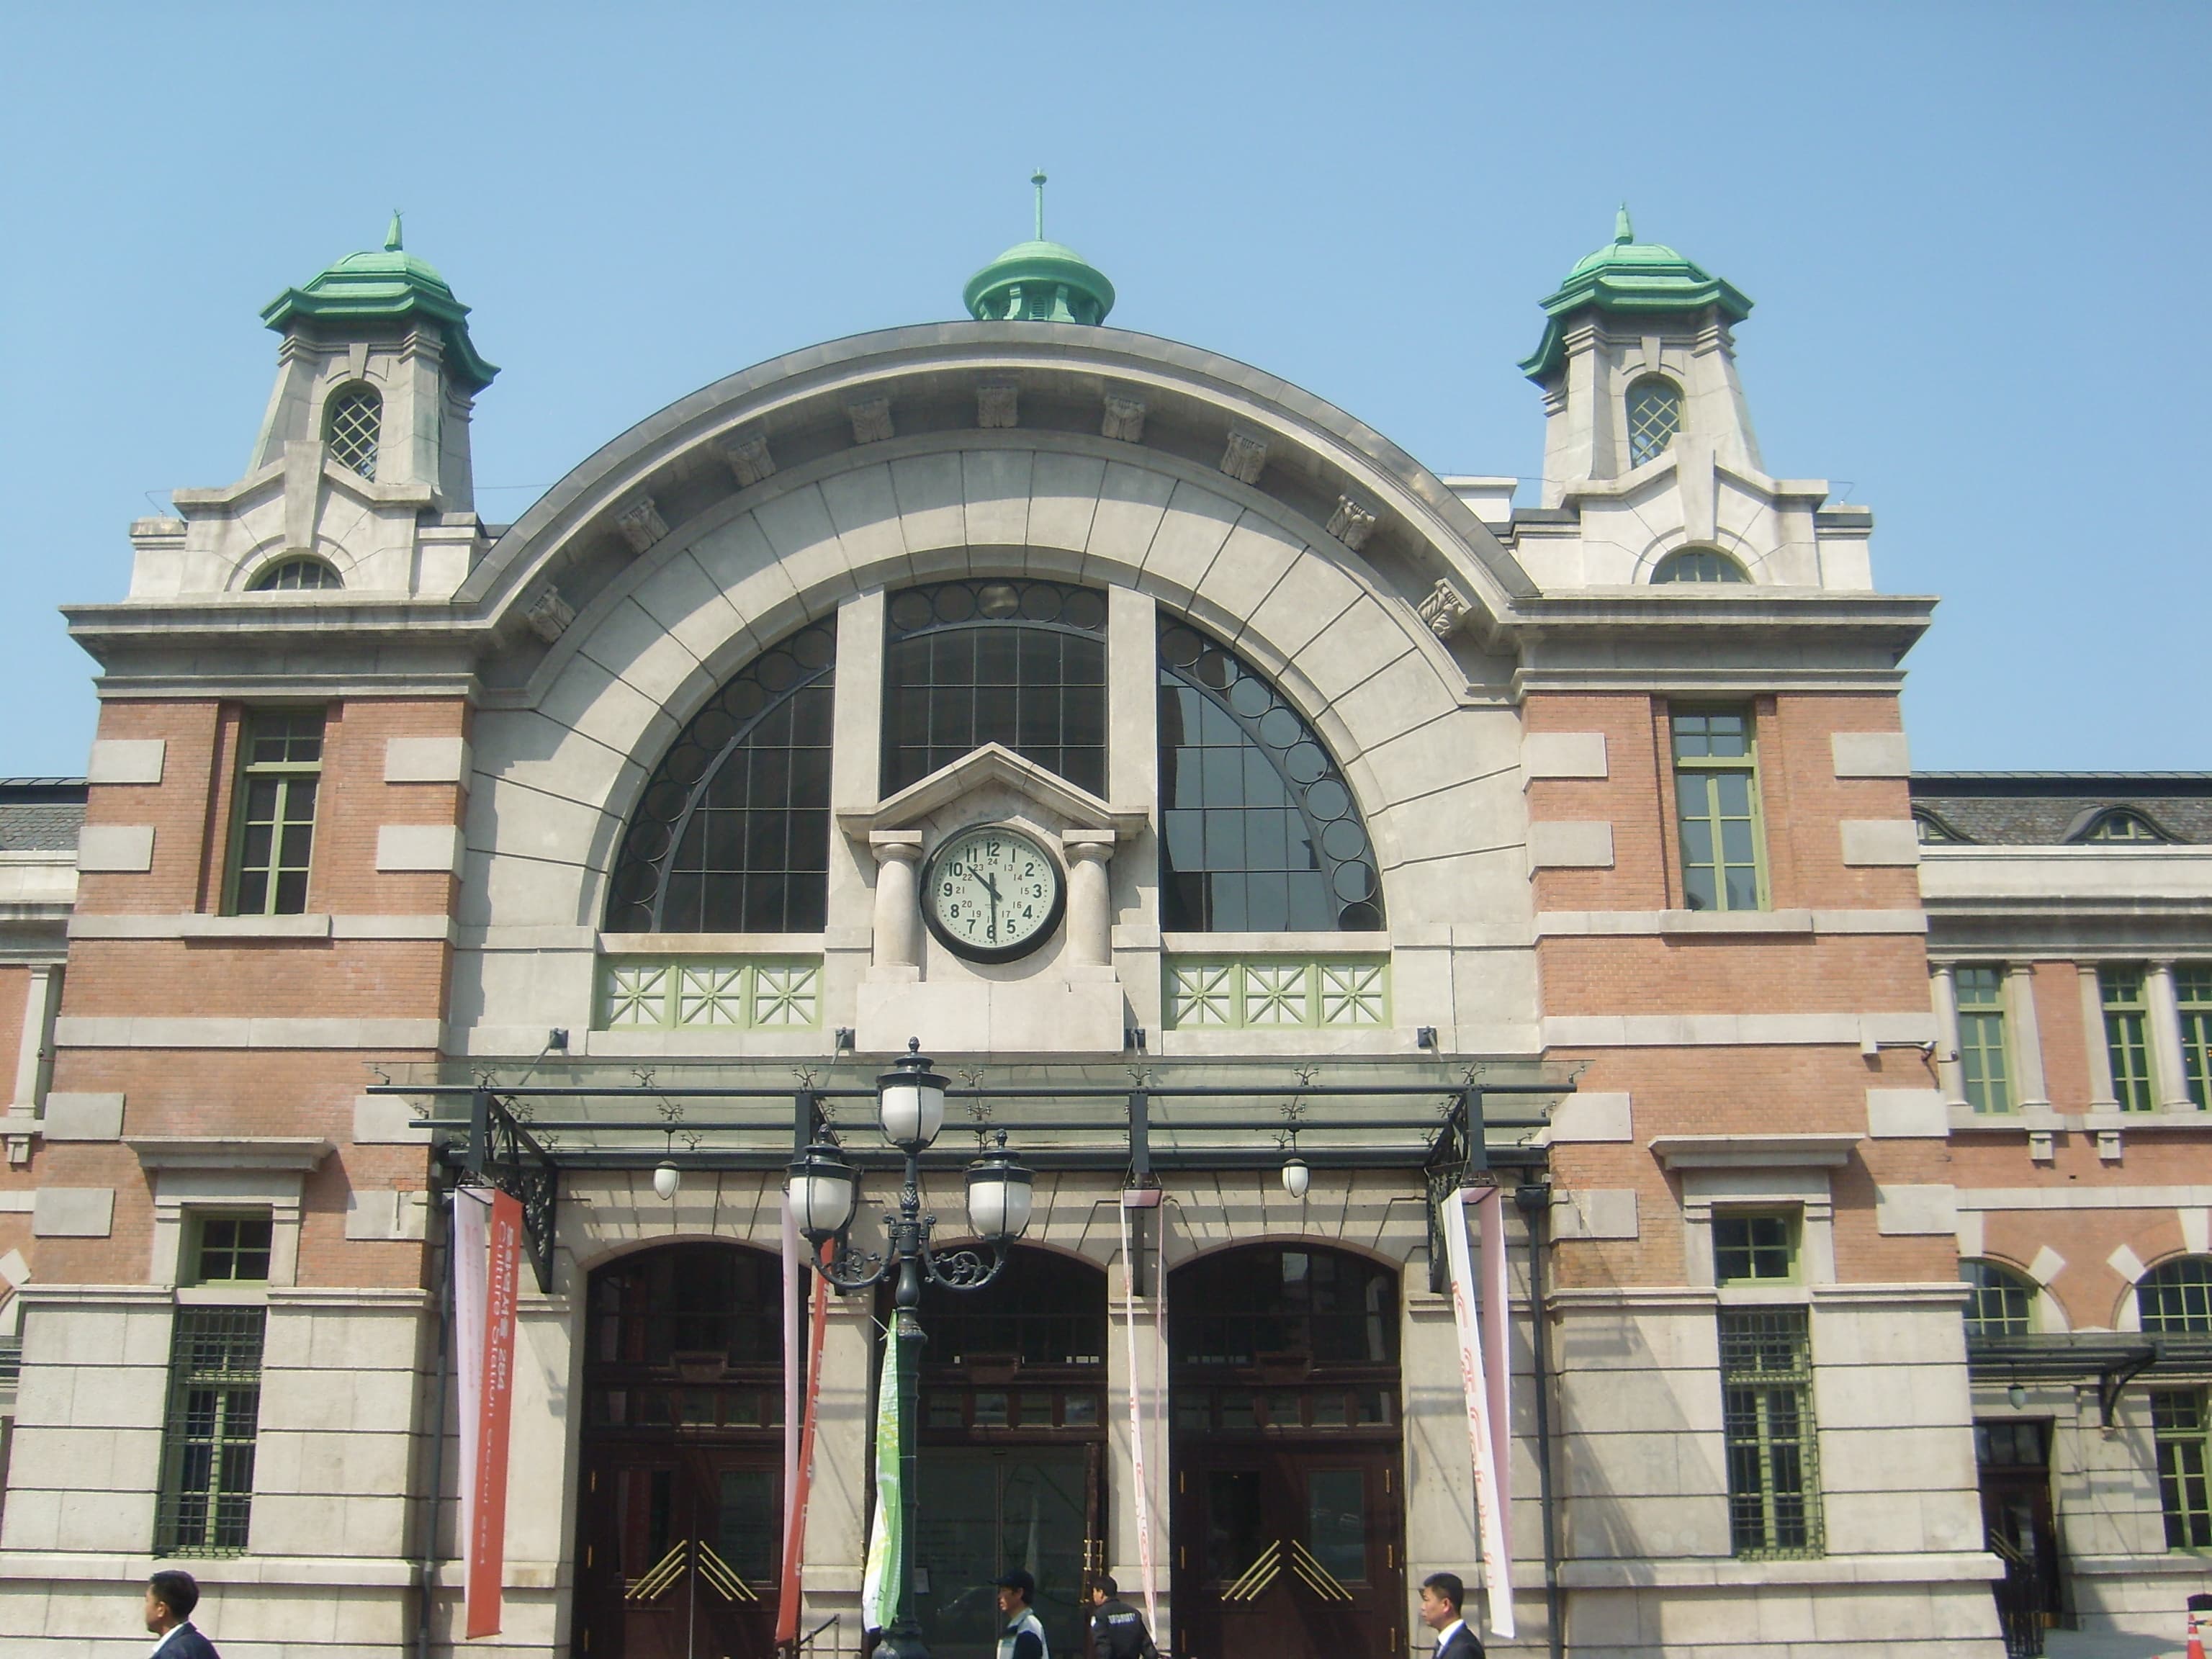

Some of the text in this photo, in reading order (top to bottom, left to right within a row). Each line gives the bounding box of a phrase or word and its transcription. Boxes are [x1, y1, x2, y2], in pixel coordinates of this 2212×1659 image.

[966, 848, 977, 863] 11
[987, 842, 1000, 856] 12
[1012, 848, 1015, 863] 1
[949, 863, 963, 877] 10
[1025, 863, 1035, 877] 2
[943, 882, 953, 896] 9
[1033, 884, 1042, 899] 3
[950, 904, 959, 918] 8
[1022, 904, 1033, 919] 4
[966, 920, 976, 934] 7
[986, 925, 997, 939] 6
[1007, 920, 1016, 934] 5
[493, 1220, 507, 1316] Culture
[487, 1326, 500, 1417] Station
[497, 1348, 507, 1390] 284
